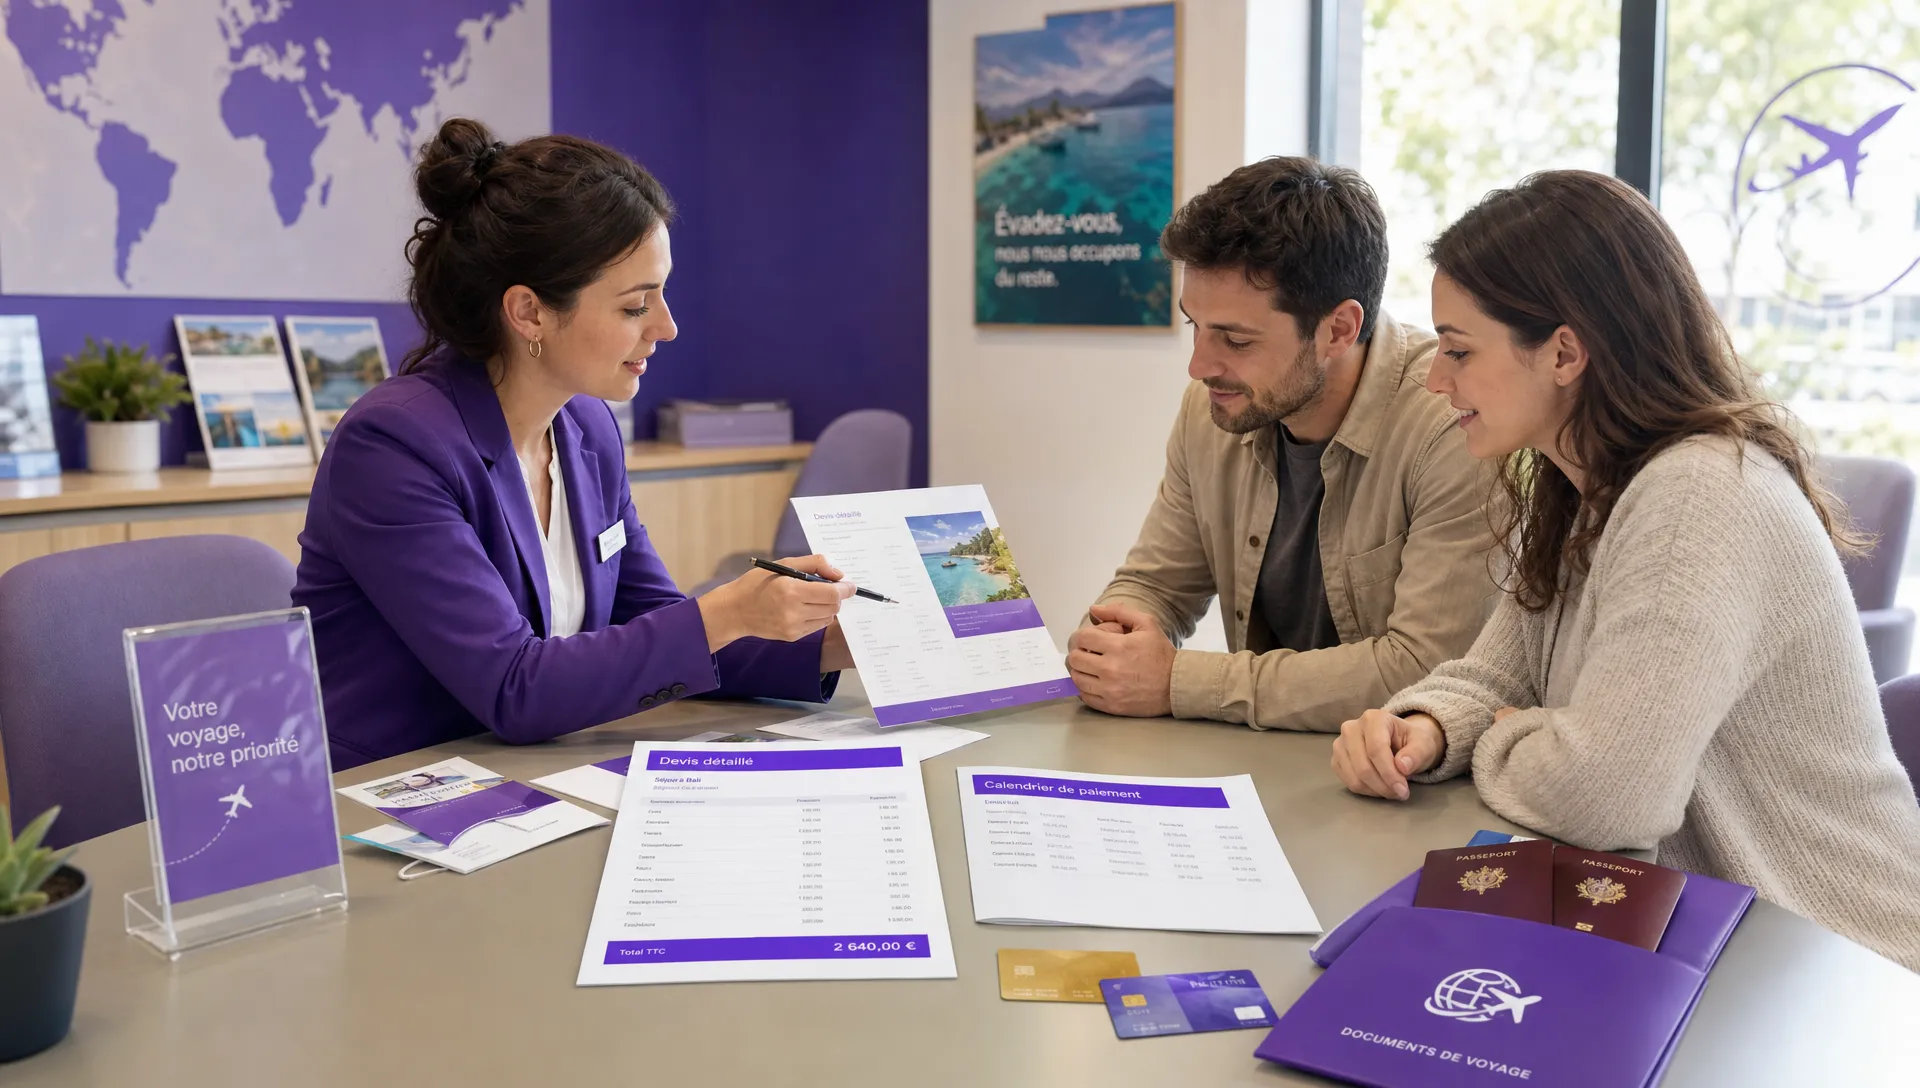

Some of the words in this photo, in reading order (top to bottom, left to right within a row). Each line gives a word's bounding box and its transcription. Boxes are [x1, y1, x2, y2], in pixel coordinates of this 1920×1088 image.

[995, 203, 1123, 236] Évadez-vous,
[995, 267, 1016, 288] du
[163, 701, 218, 722] Votre
[167, 722, 246, 748] voyage,
[171, 752, 225, 774] notre
[230, 735, 300, 767] priorité
[659, 756, 699, 766] Devis
[703, 757, 754, 766] détaillé
[984, 780, 1055, 793] Calendrier
[1058, 784, 1075, 794] de
[1079, 788, 1142, 799] paiement
[1455, 850, 1518, 862] PASSEPORT
[1582, 858, 1645, 877] PASSEPORT
[619, 948, 644, 956] Total
[833, 942, 843, 952] 2
[847, 941, 901, 953] 640,00
[905, 941, 917, 951] €
[1340, 1026, 1438, 1057] DOCUMENTS
[1439, 1050, 1463, 1063] DE
[1466, 1056, 1532, 1080] VOYAGE
